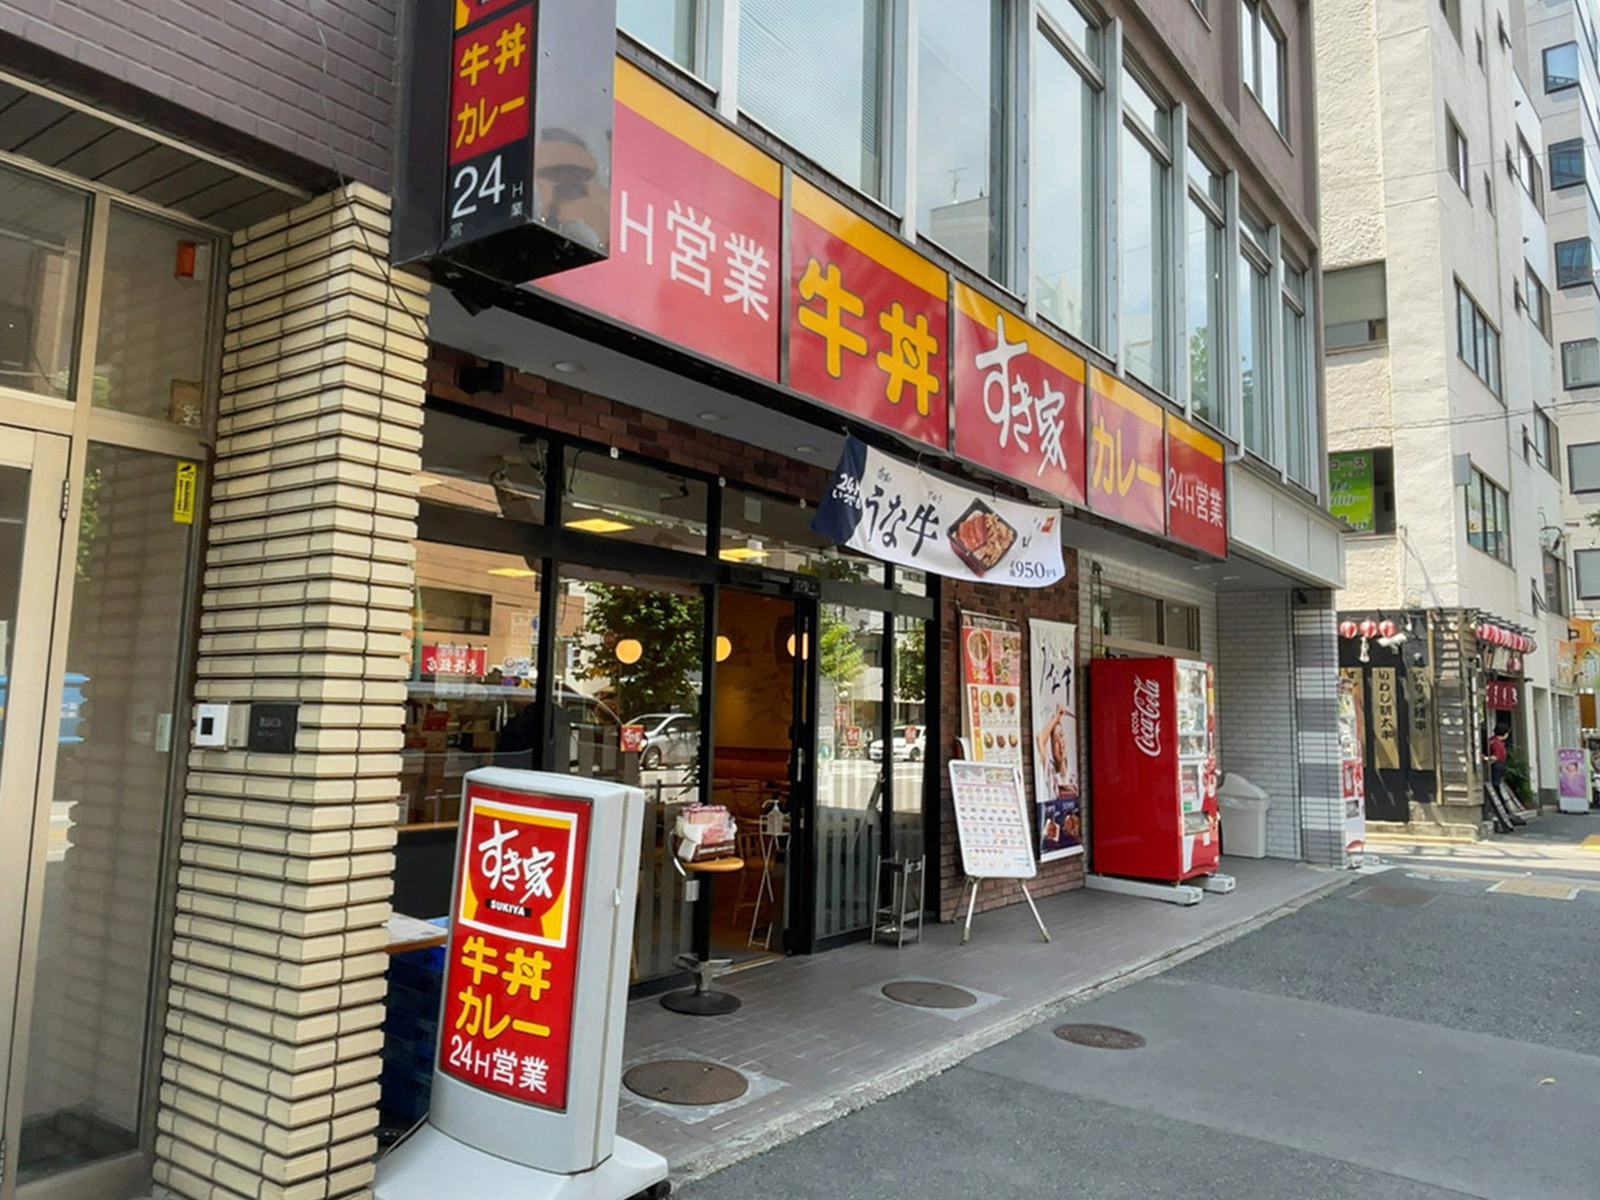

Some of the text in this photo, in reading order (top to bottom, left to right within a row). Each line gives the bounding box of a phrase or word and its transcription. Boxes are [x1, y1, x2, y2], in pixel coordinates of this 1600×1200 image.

[460, 22, 526, 86] 牛丼
[455, 96, 526, 149] カレー
[797, 257, 940, 418] 牛丼
[976, 313, 1067, 478] すき家
[1092, 414, 1162, 498] カレー
[865, 484, 940, 558] うな牛
[1169, 466, 1223, 529] 24H営業
[1133, 674, 1162, 757] Coca-Cola
[478, 819, 555, 903] すき家
[490, 899, 526, 916] SUKIYA
[460, 935, 552, 1001] 牛丼
[455, 985, 551, 1040] カレー
[449, 1035, 549, 1094] 24H営業
